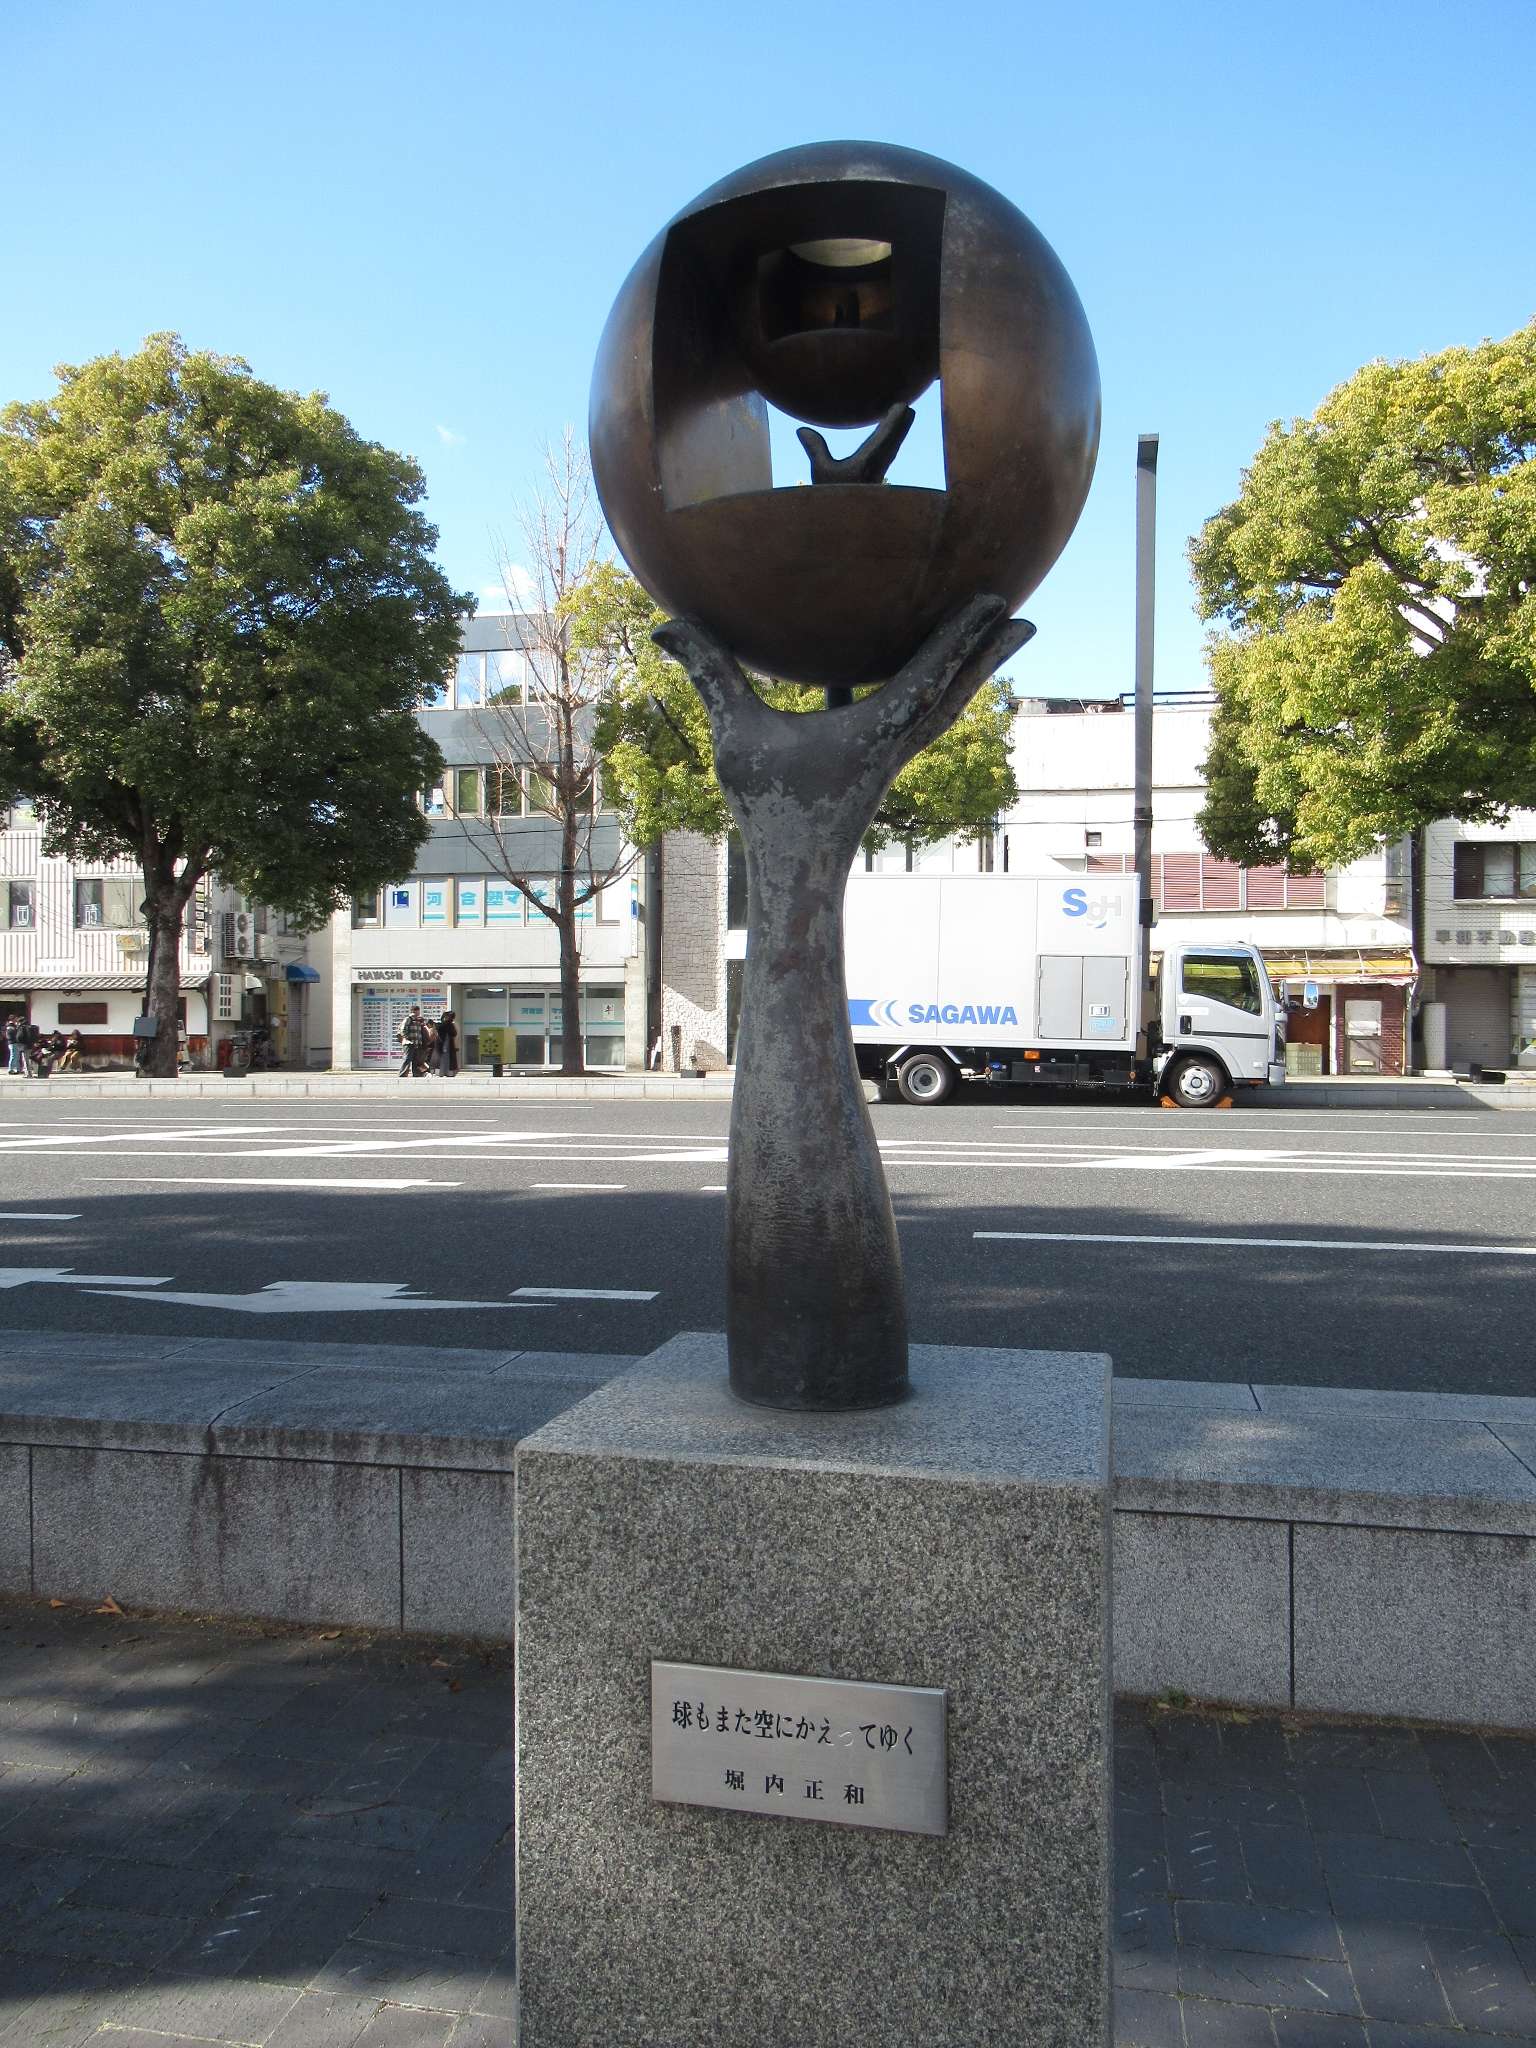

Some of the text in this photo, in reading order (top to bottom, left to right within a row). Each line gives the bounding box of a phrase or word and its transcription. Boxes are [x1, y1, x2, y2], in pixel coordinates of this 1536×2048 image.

[357, 970, 403, 980] HAYASHI
[908, 1004, 1018, 1025] SAGAWA
[672, 1701, 913, 1755] 球もまた空にかえってゆく
[725, 1768, 865, 1804] 堀内正和
